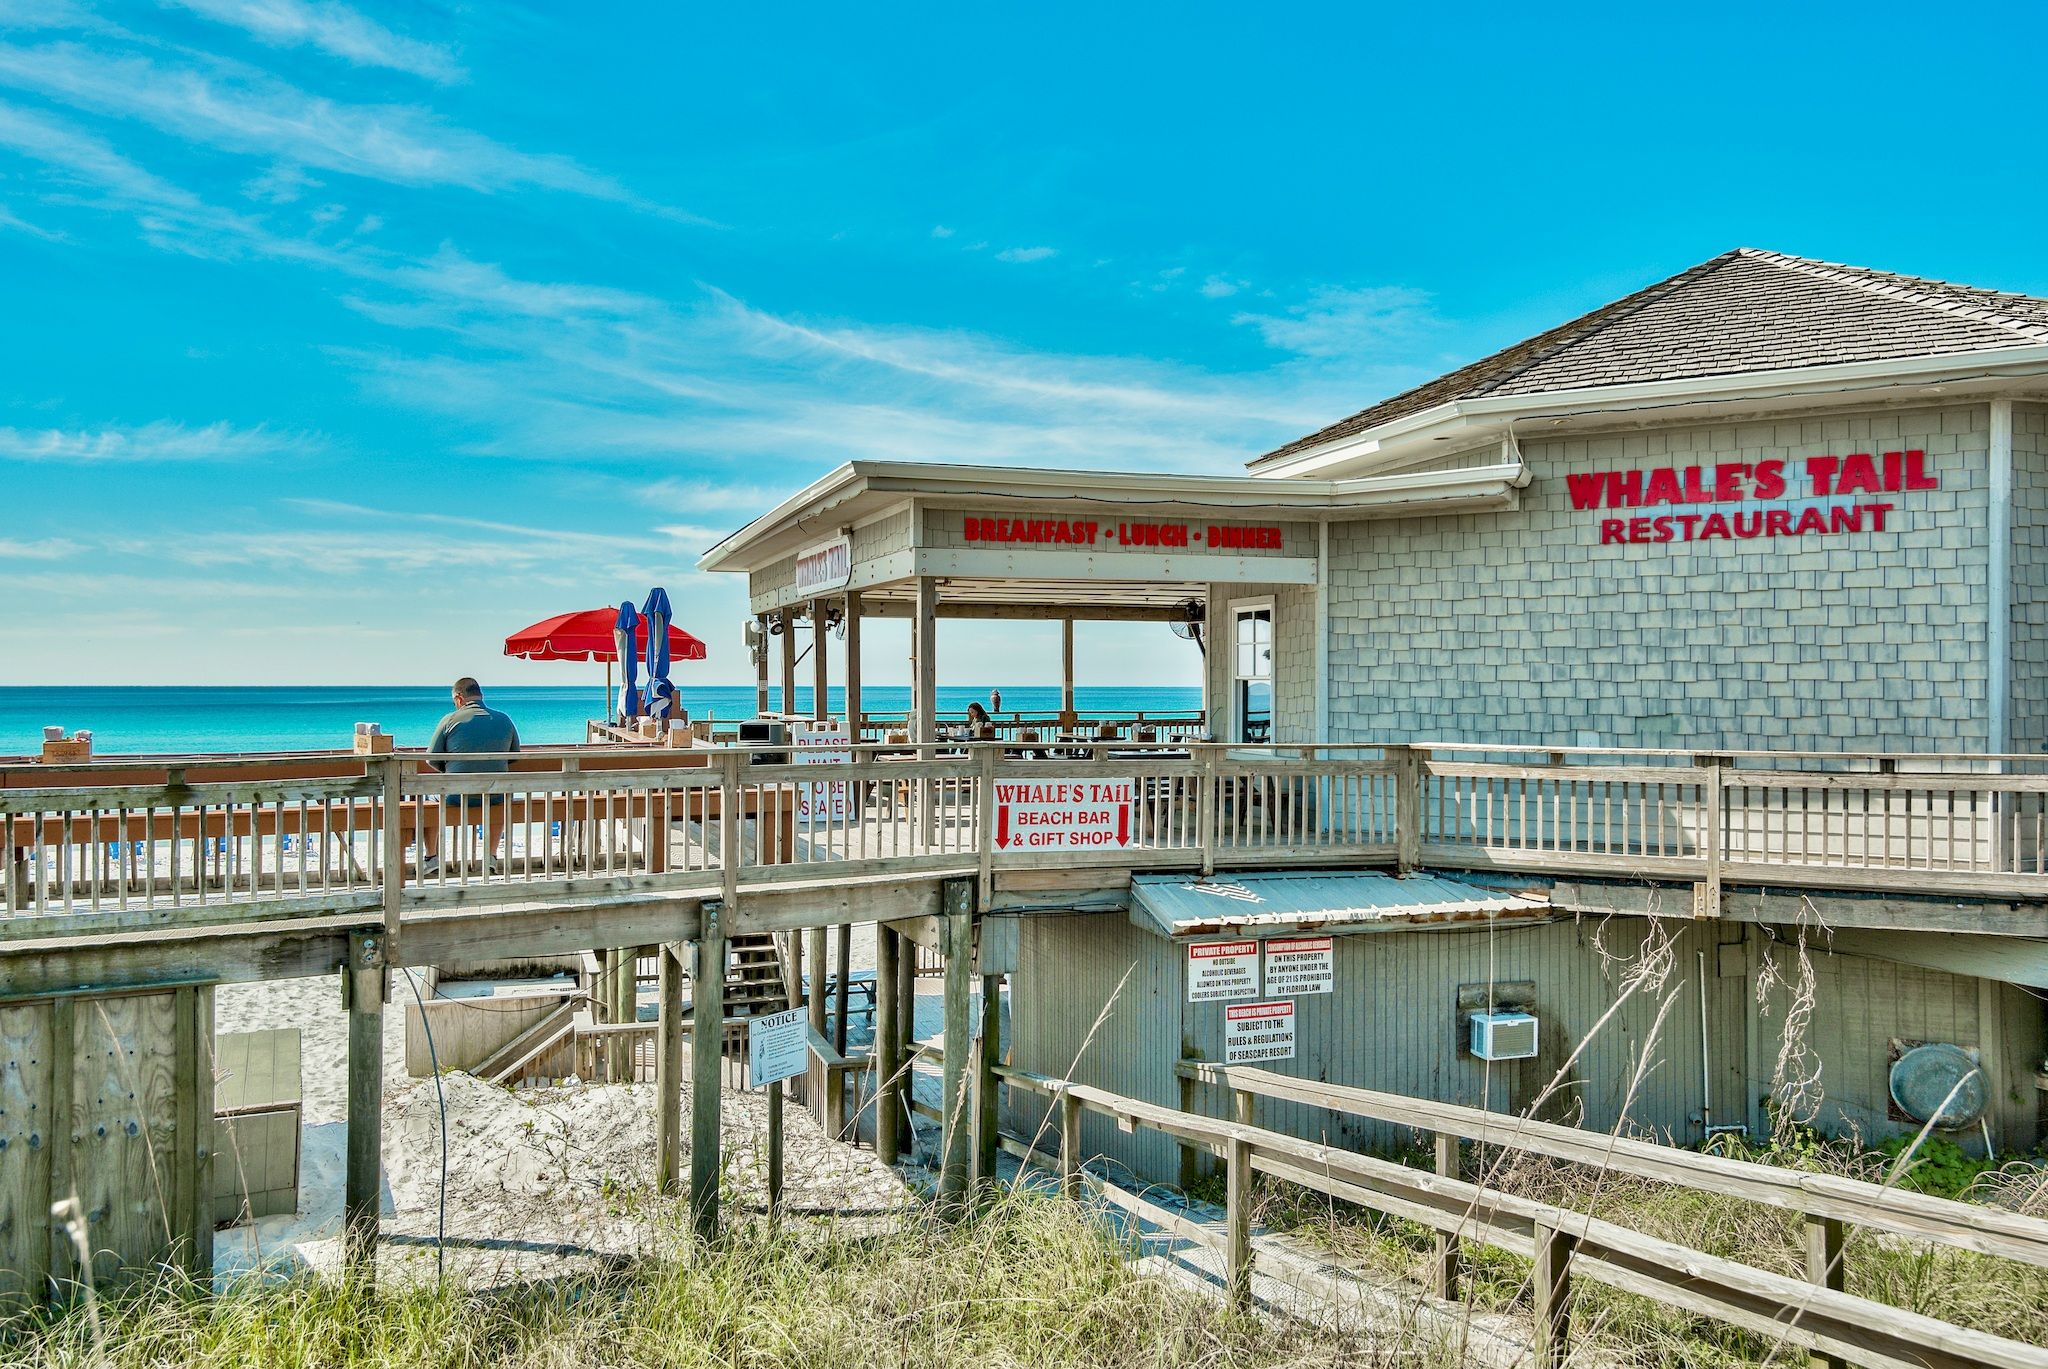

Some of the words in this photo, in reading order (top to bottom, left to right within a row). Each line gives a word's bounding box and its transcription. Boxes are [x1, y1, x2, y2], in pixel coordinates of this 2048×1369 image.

[1566, 460, 1785, 509] WHALE'S
[1807, 450, 1938, 496] TAIL
[1601, 504, 1894, 545] RESTAURANT
[964, 518, 1098, 544] BREAKFAST
[1119, 523, 1188, 547] LUNCH
[1207, 526, 1282, 549] DINNER
[995, 784, 1084, 803] WHALE'S
[1018, 812, 1072, 825] BEACH
[1078, 811, 1110, 824] BAR
[1013, 833, 1023, 846] &
[1029, 832, 1065, 845] GIFT
[1069, 831, 1113, 845] SHOP
[1193, 946, 1220, 957] PRIVATE
[1221, 944, 1255, 955] PROPERTY
[1297, 953, 1324, 961] PROPERTY
[1202, 969, 1223, 977] ALCOHOLIC
[1224, 968, 1246, 976] BEVERAGES
[1278, 965, 1298, 973] ANYONE
[1300, 973, 1331, 982] PROHIBITED
[1192, 991, 1209, 999] COOLERS
[1210, 990, 1226, 998] SUBJECT
[1286, 985, 1308, 993] FLORIDA
[761, 1012, 797, 1030] NOTICE
[1237, 1021, 1263, 1031] SUBJECT
[1265, 1020, 1271, 1029] TO
[1273, 1019, 1284, 1028] THE
[1228, 1036, 1246, 1046] RULES
[1254, 1033, 1292, 1044] REGULATIONS
[1230, 1052, 1236, 1060] OF
[1238, 1049, 1268, 1059] SEASCAPE
[1270, 1047, 1291, 1057] RESORT
